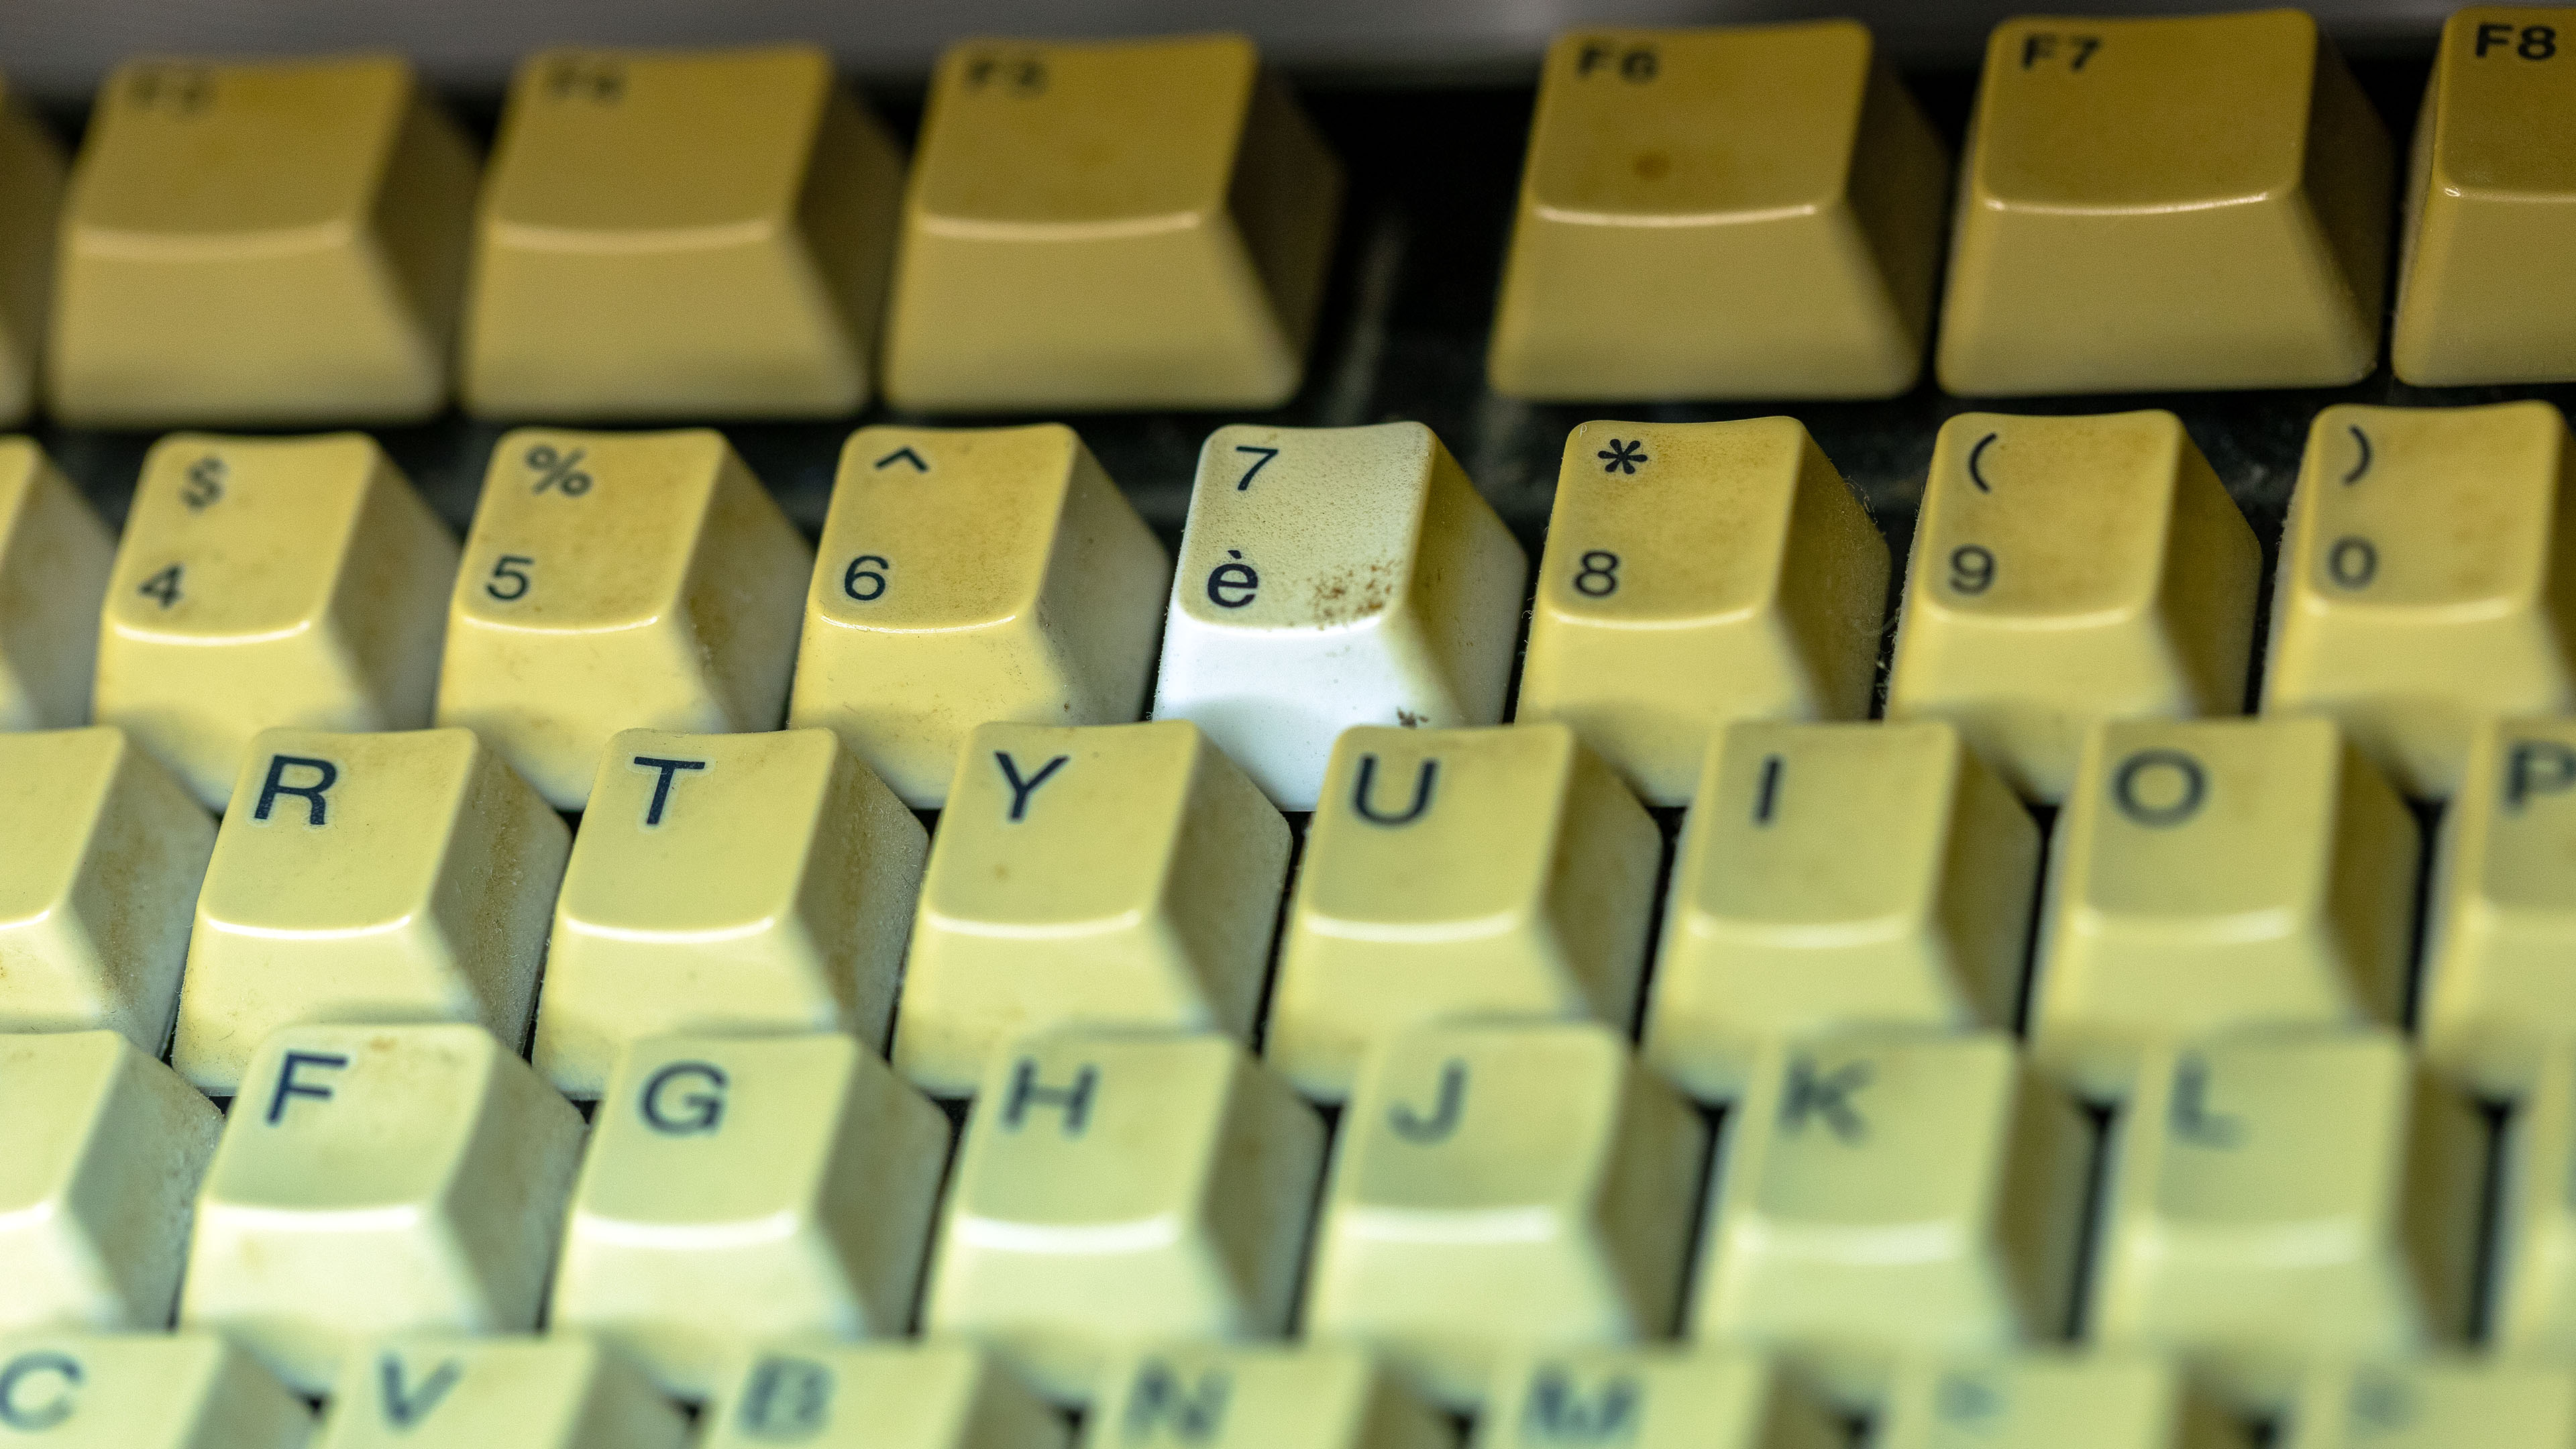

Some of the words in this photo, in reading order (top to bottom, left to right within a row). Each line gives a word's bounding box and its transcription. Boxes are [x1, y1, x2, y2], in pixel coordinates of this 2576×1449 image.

[1576, 42, 1658, 82] F6
[2021, 32, 2102, 72] F7
[2476, 23, 2556, 60] F8
[181, 456, 226, 512] $
[525, 444, 593, 498] %
[876, 447, 927, 472] ^
[1236, 445, 1278, 491] 7
[1966, 433, 1997, 493] (
[2345, 426, 2372, 484] )
[140, 566, 181, 607] 4
[486, 555, 532, 601] 5
[844, 555, 888, 601] 6
[1208, 545, 1258, 608] è
[1573, 551, 1619, 598] 8
[1951, 545, 1995, 594] 9
[2328, 537, 2378, 587] 0
[254, 755, 337, 825] R
[634, 756, 705, 825] T
[996, 752, 1067, 820] Y
[1352, 756, 1437, 825] U
[1752, 754, 1783, 825] I
[2110, 748, 2209, 827] O
[2501, 740, 2576, 812] P
[266, 1052, 347, 1124] F
[640, 1063, 727, 1133] G
[1002, 1060, 1099, 1135] H
[1387, 1060, 1470, 1145] J
[1779, 1059, 1875, 1142] K
[2167, 1053, 2247, 1148] L
[0, 1354, 83, 1428] C
[378, 1354, 463, 1432] V
